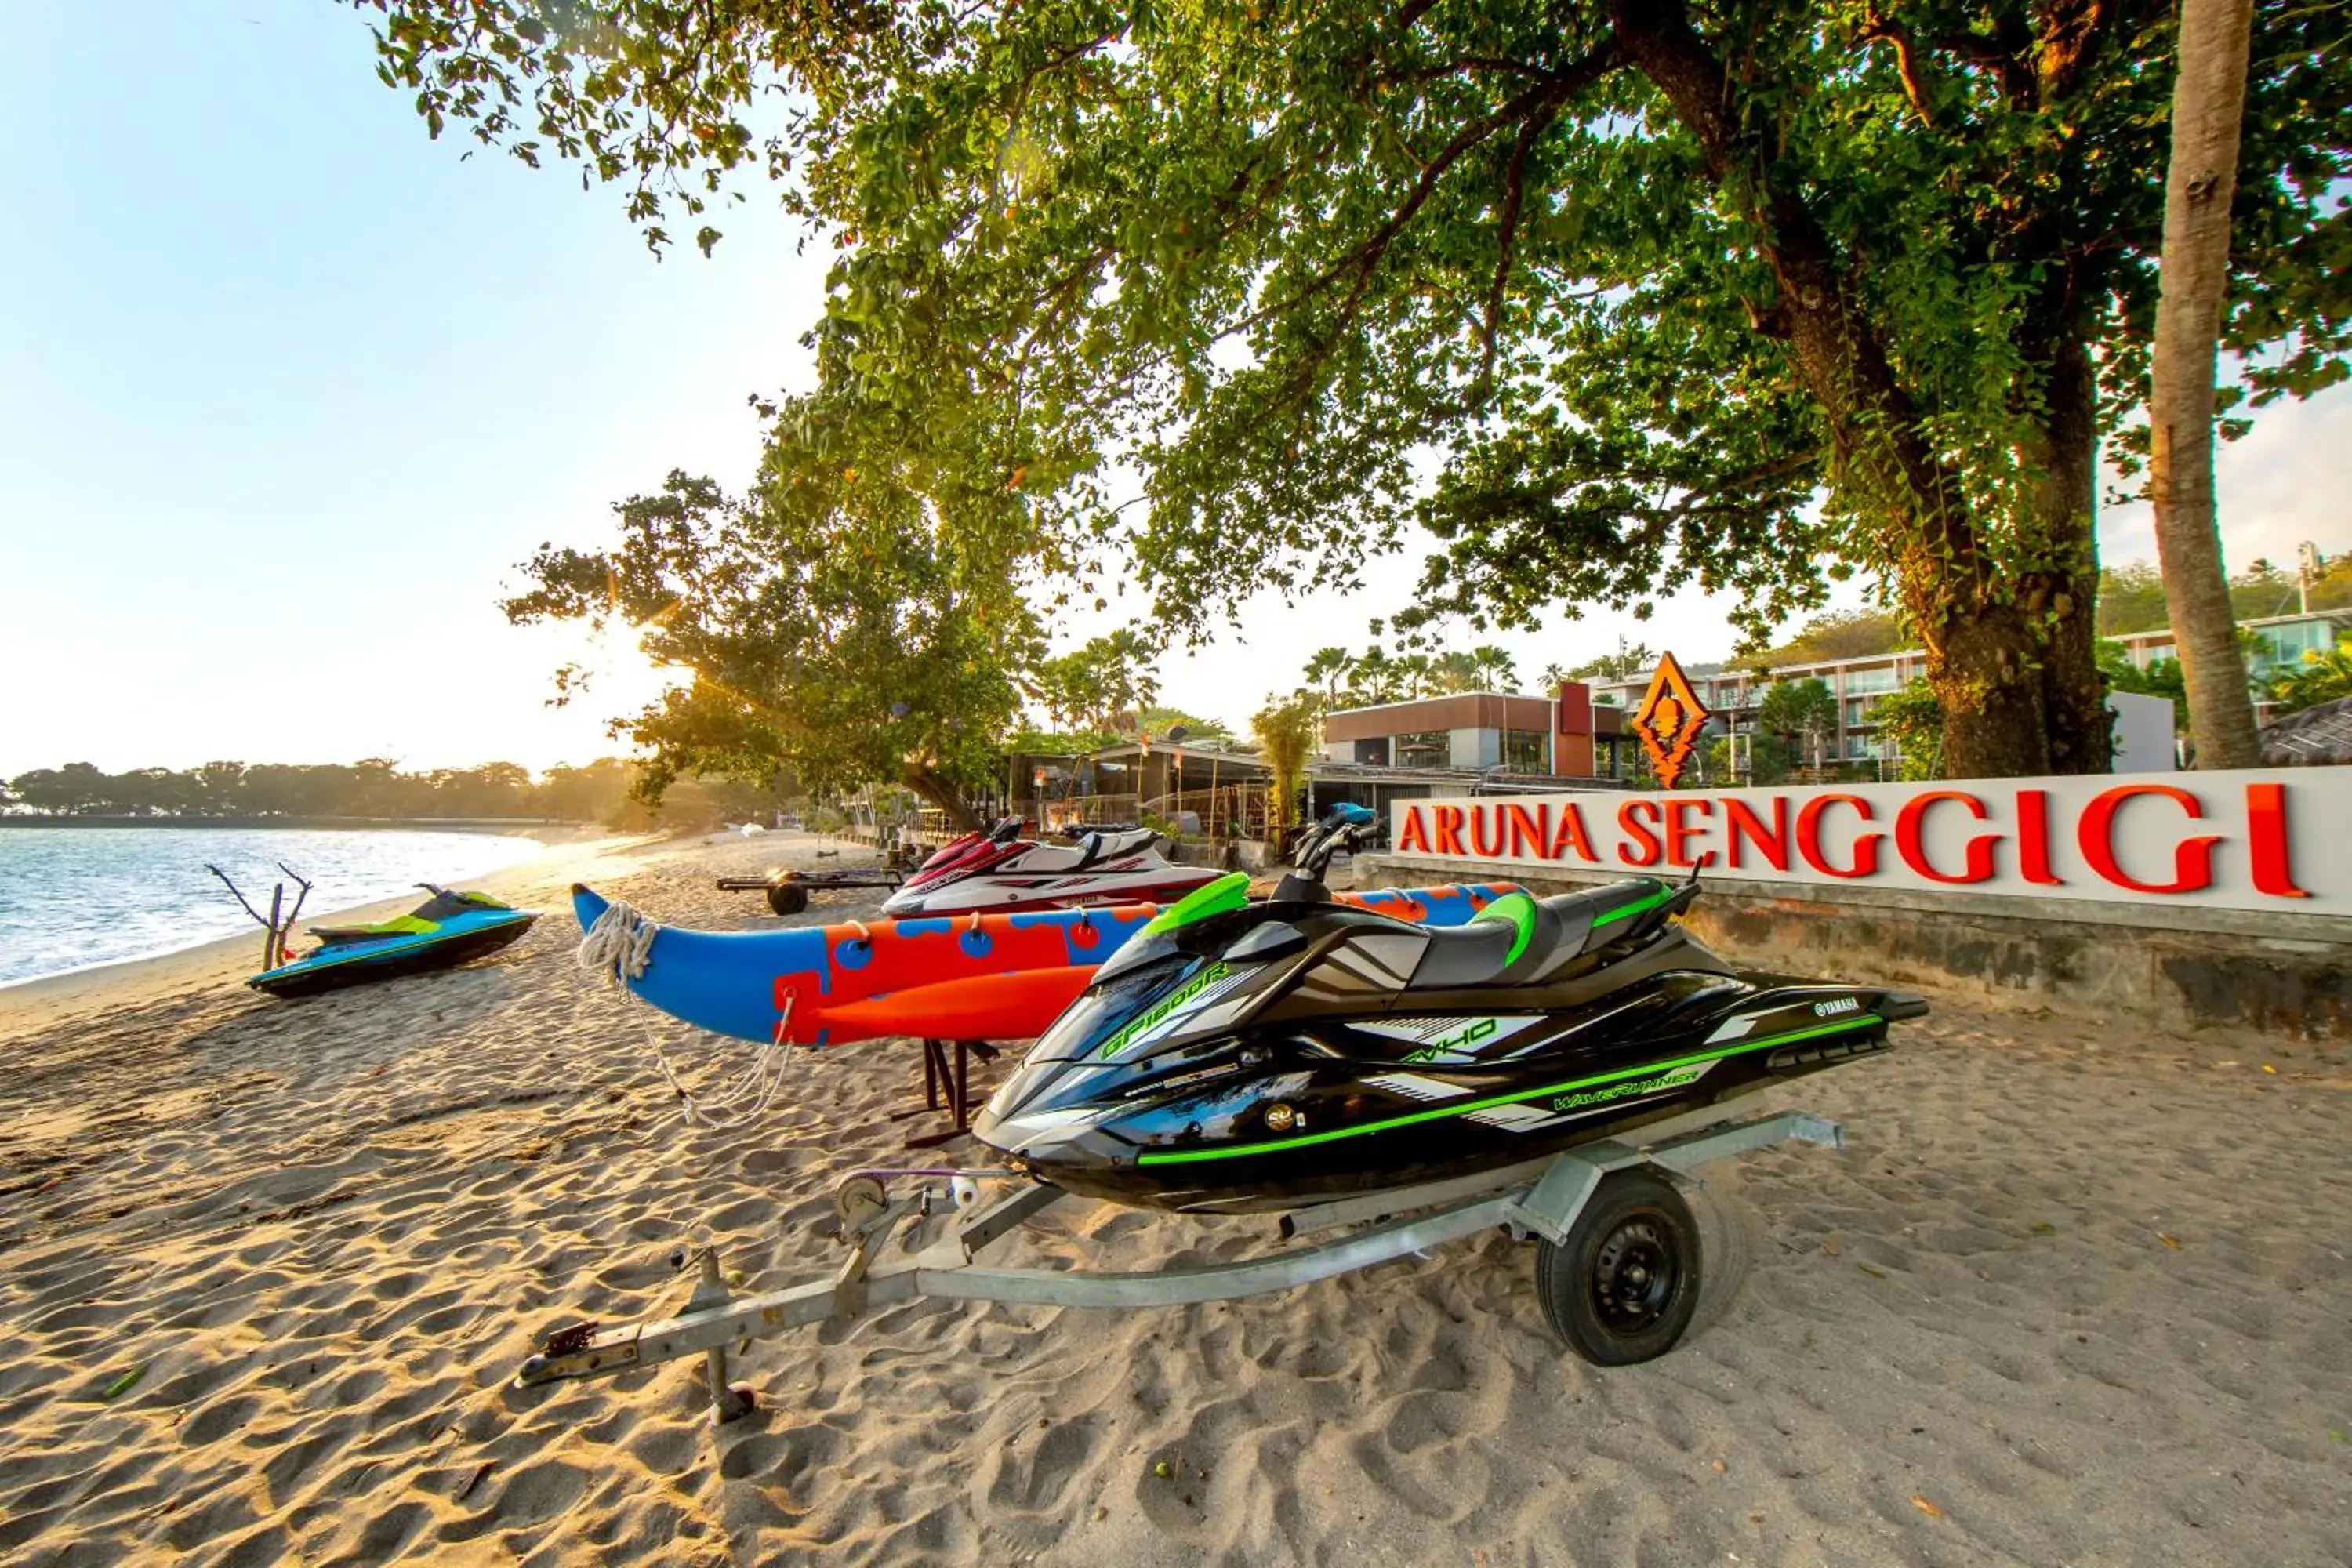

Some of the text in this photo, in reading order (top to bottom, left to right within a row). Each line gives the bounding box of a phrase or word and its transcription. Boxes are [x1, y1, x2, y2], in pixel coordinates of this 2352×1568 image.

[1399, 782, 2311, 899] ARUNA SENGGIGI
[1101, 961, 1230, 1060] GP1800R
[1824, 996, 1860, 1014] YAMAHA
[1553, 1070, 1699, 1111] WAVERUNNER
